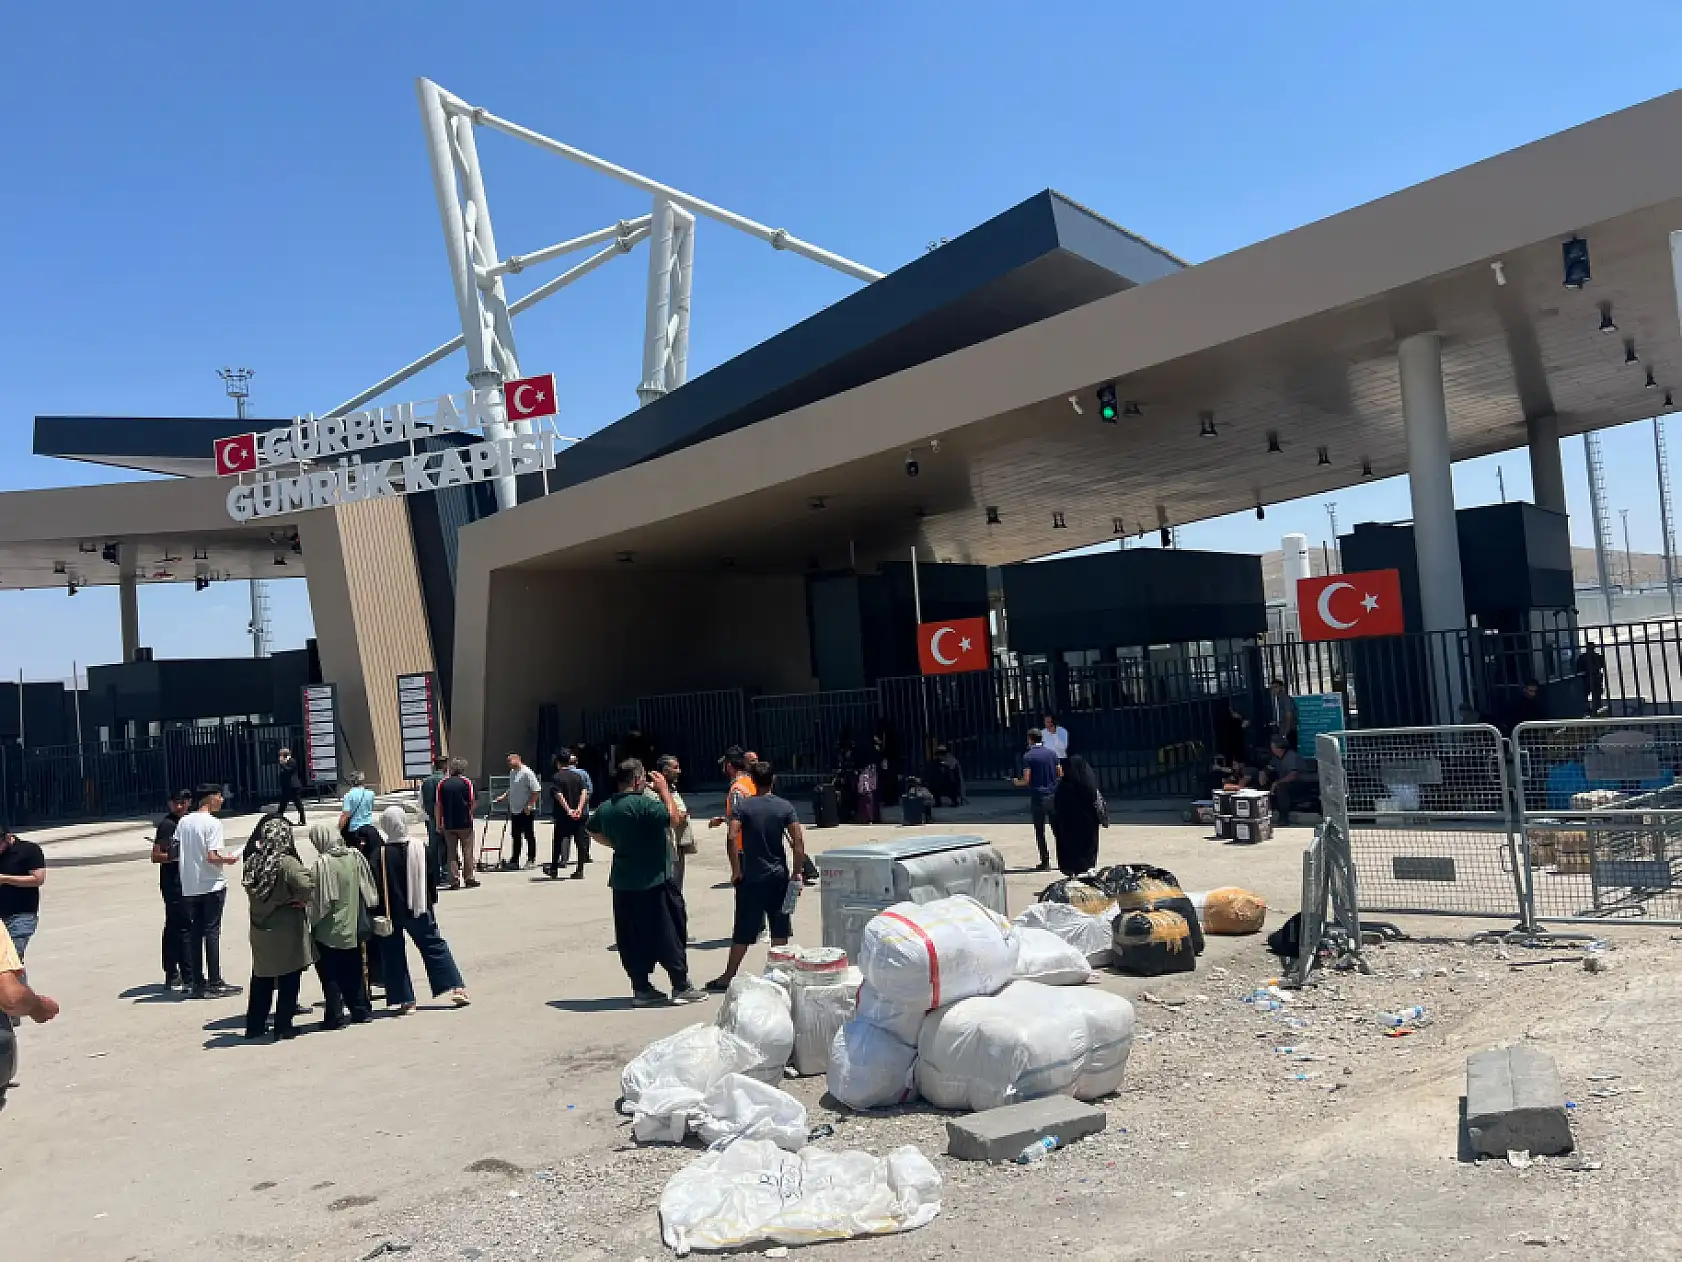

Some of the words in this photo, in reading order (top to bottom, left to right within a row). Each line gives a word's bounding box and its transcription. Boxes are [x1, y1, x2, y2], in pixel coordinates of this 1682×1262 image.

[262, 388, 495, 465] GÜRBULAK
[226, 455, 396, 521] GÜMRÜK
[402, 430, 556, 493] KAPISI
